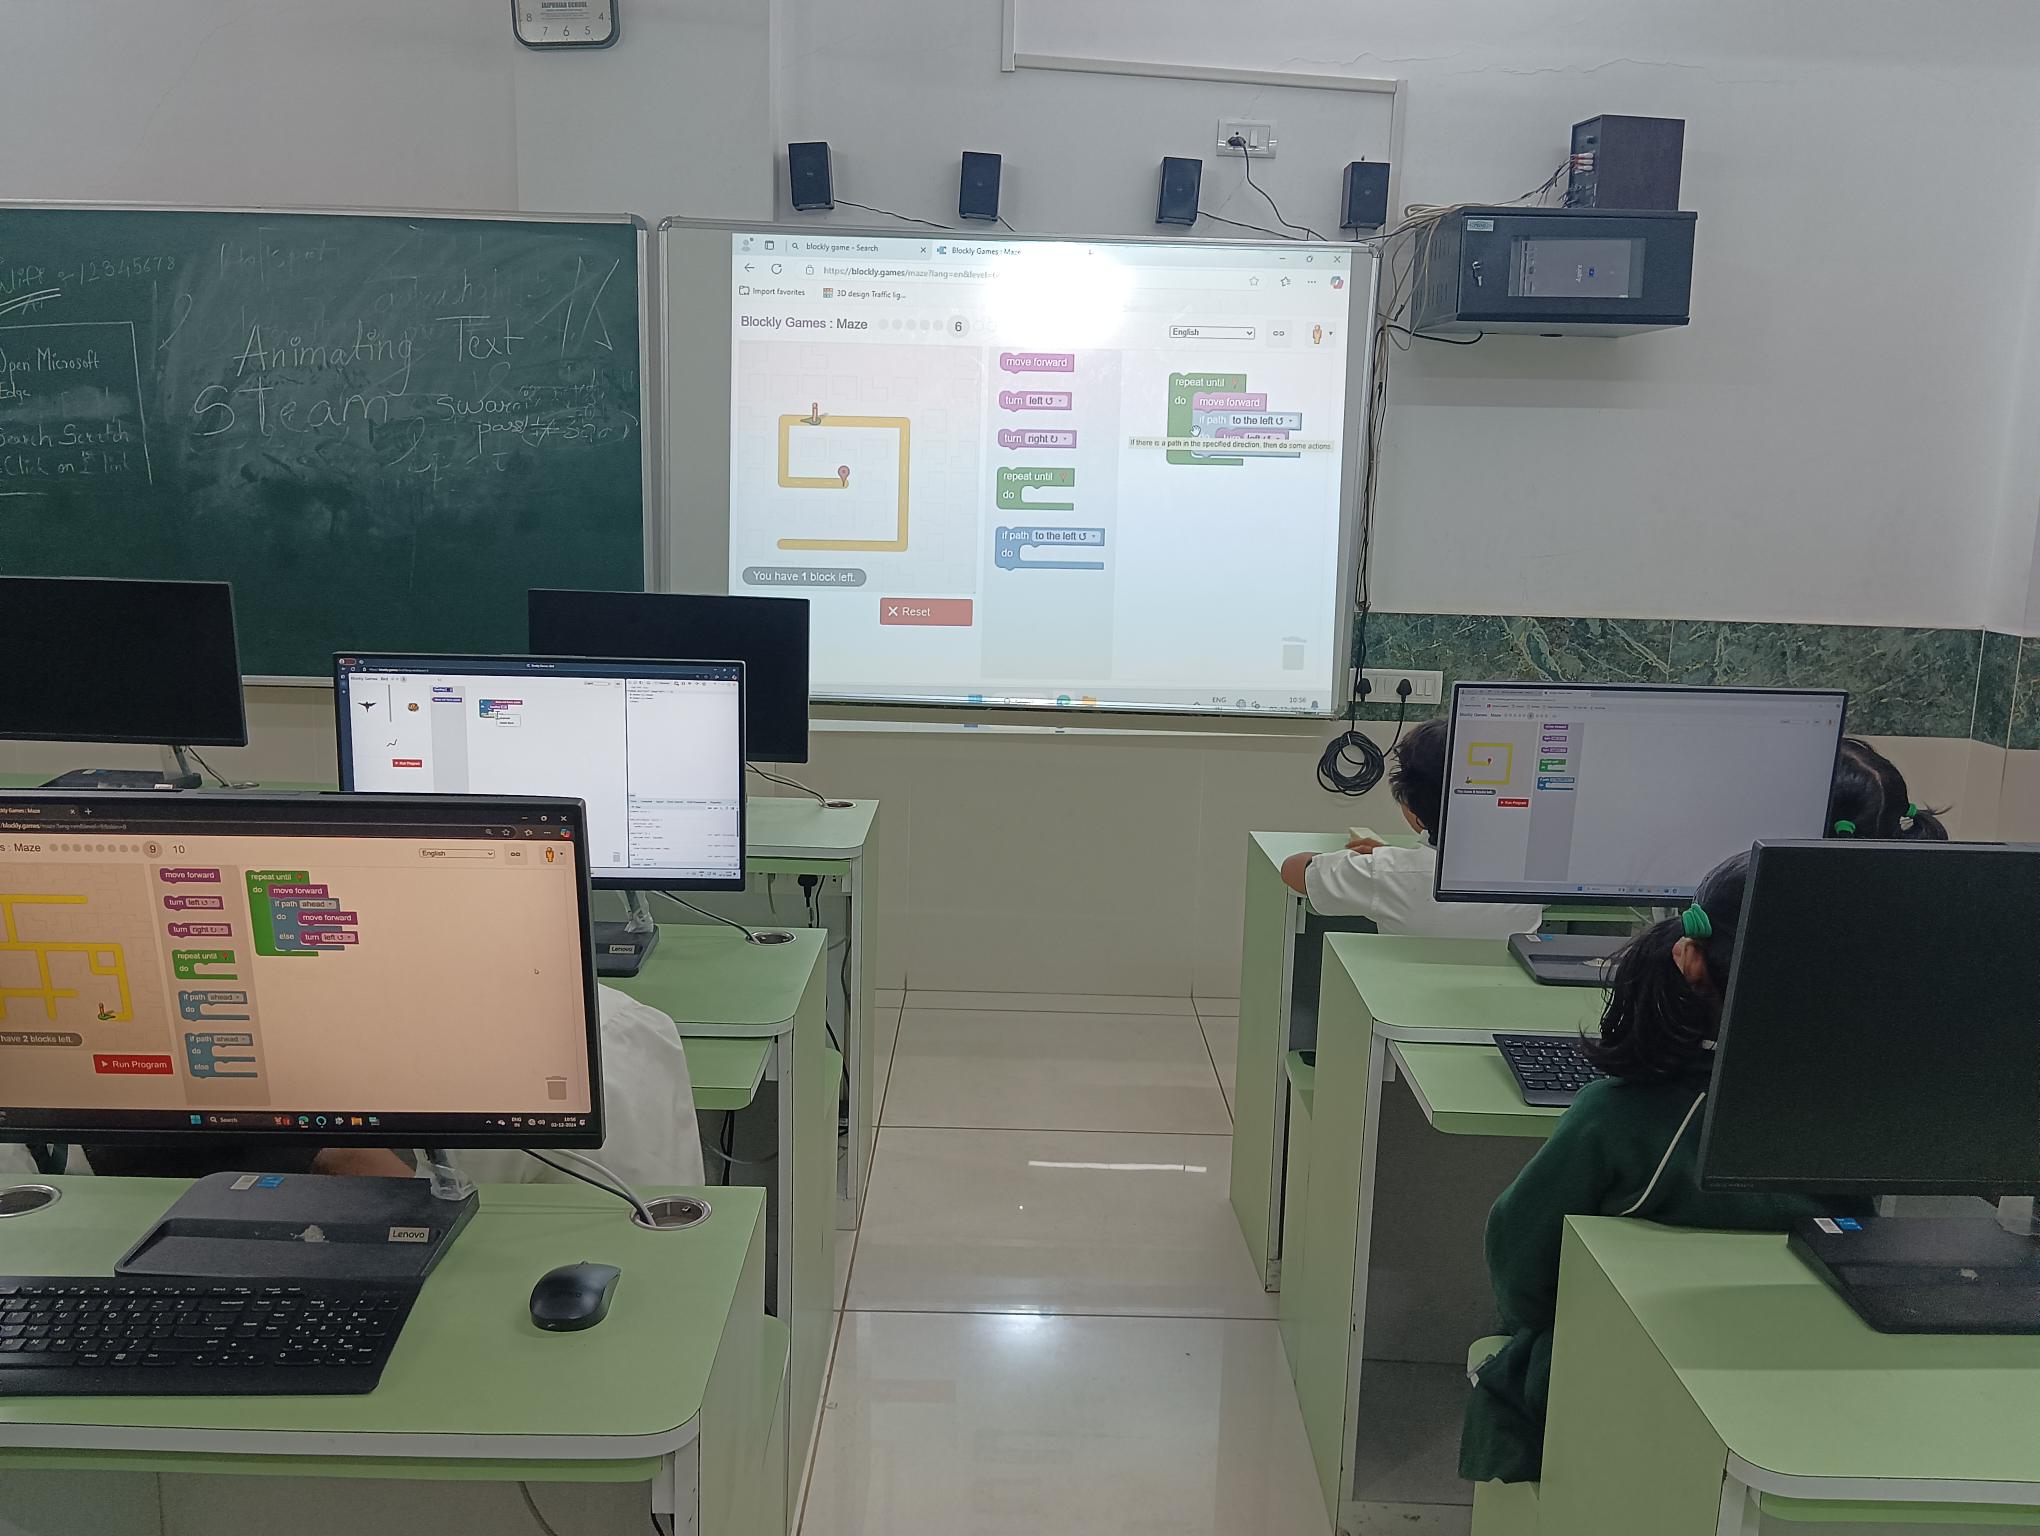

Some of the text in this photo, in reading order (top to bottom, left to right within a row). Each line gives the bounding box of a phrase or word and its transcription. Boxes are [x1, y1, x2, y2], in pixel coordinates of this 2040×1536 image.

[526, 13, 532, 22] 8
[598, 12, 604, 21] 4
[543, 27, 548, 35] 7
[563, 26, 570, 36] 6
[584, 26, 591, 35] 5
[806, 243, 829, 252] blockly
[856, 244, 878, 252] Search
[952, 247, 976, 256] Blockly
[752, 288, 805, 296] Import favorites
[848, 290, 870, 299] design
[872, 290, 891, 298] Traffic
[740, 316, 782, 330] Blockly
[785, 316, 826, 329] Games
[836, 318, 868, 330] Maze
[955, 321, 962, 332] 6
[1172, 328, 1200, 337] English
[38, 347, 100, 372] Microsoft
[233, 315, 525, 396] Animating Text
[1006, 358, 1068, 367] move forward
[1175, 378, 1224, 388] repeat until
[1029, 396, 1042, 405] left
[1174, 396, 1260, 407] do move forward
[1232, 416, 1242, 424] to
[1243, 416, 1258, 424] the
[1260, 416, 1274, 425] left
[1028, 434, 1048, 444] right
[1168, 440, 1182, 448] path
[58, 463, 75, 473] on
[1004, 472, 1053, 482] repeat until
[1002, 490, 1014, 499] do
[1002, 531, 1076, 540] if path to the left
[1002, 548, 1014, 558] do
[753, 572, 856, 582] You have 1 block left.
[902, 607, 931, 617] Reset
[14, 843, 41, 852] Maze
[150, 845, 156, 853] 9
[173, 845, 185, 854] 10
[422, 850, 446, 858] English
[251, 874, 274, 882] repeat
[281, 900, 298, 908] path
[279, 932, 294, 940] else
[190, 994, 206, 1002] path
[30, 1035, 57, 1043] blocks
[112, 1060, 167, 1070] Run Program
[392, 1230, 425, 1238] Lenovo
